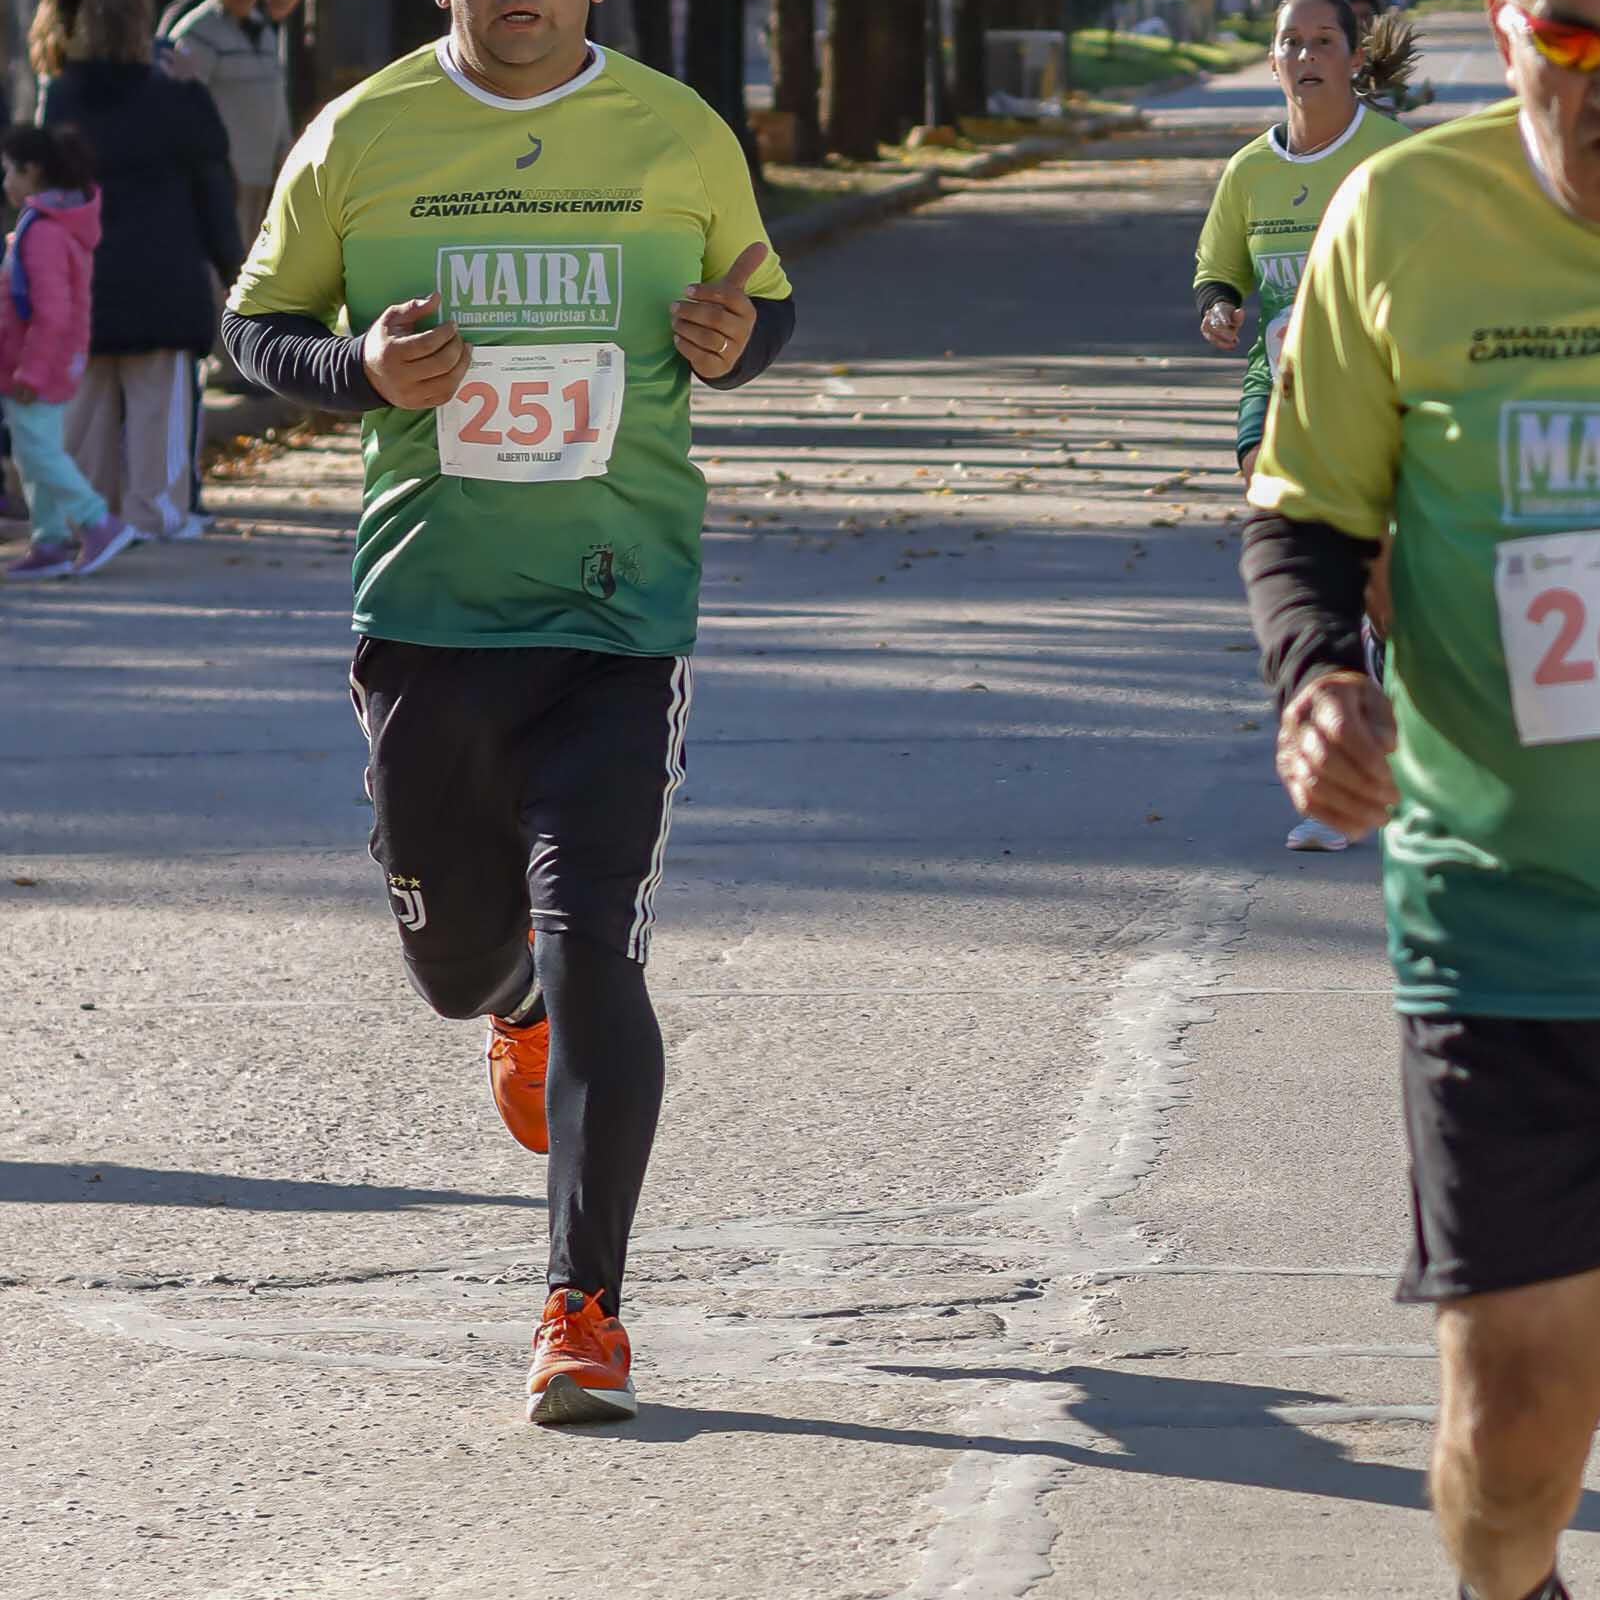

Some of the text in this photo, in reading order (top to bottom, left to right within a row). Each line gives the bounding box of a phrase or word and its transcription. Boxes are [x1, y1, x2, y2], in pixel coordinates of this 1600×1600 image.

[409, 199, 644, 218] CAWILLIAMSKEMMIS
[448, 252, 612, 307] MAIRA
[450, 310, 517, 325] Almacenes
[521, 309, 586, 325] Mayoristas
[455, 379, 601, 446] 251
[496, 452, 530, 463] ALBERTO
